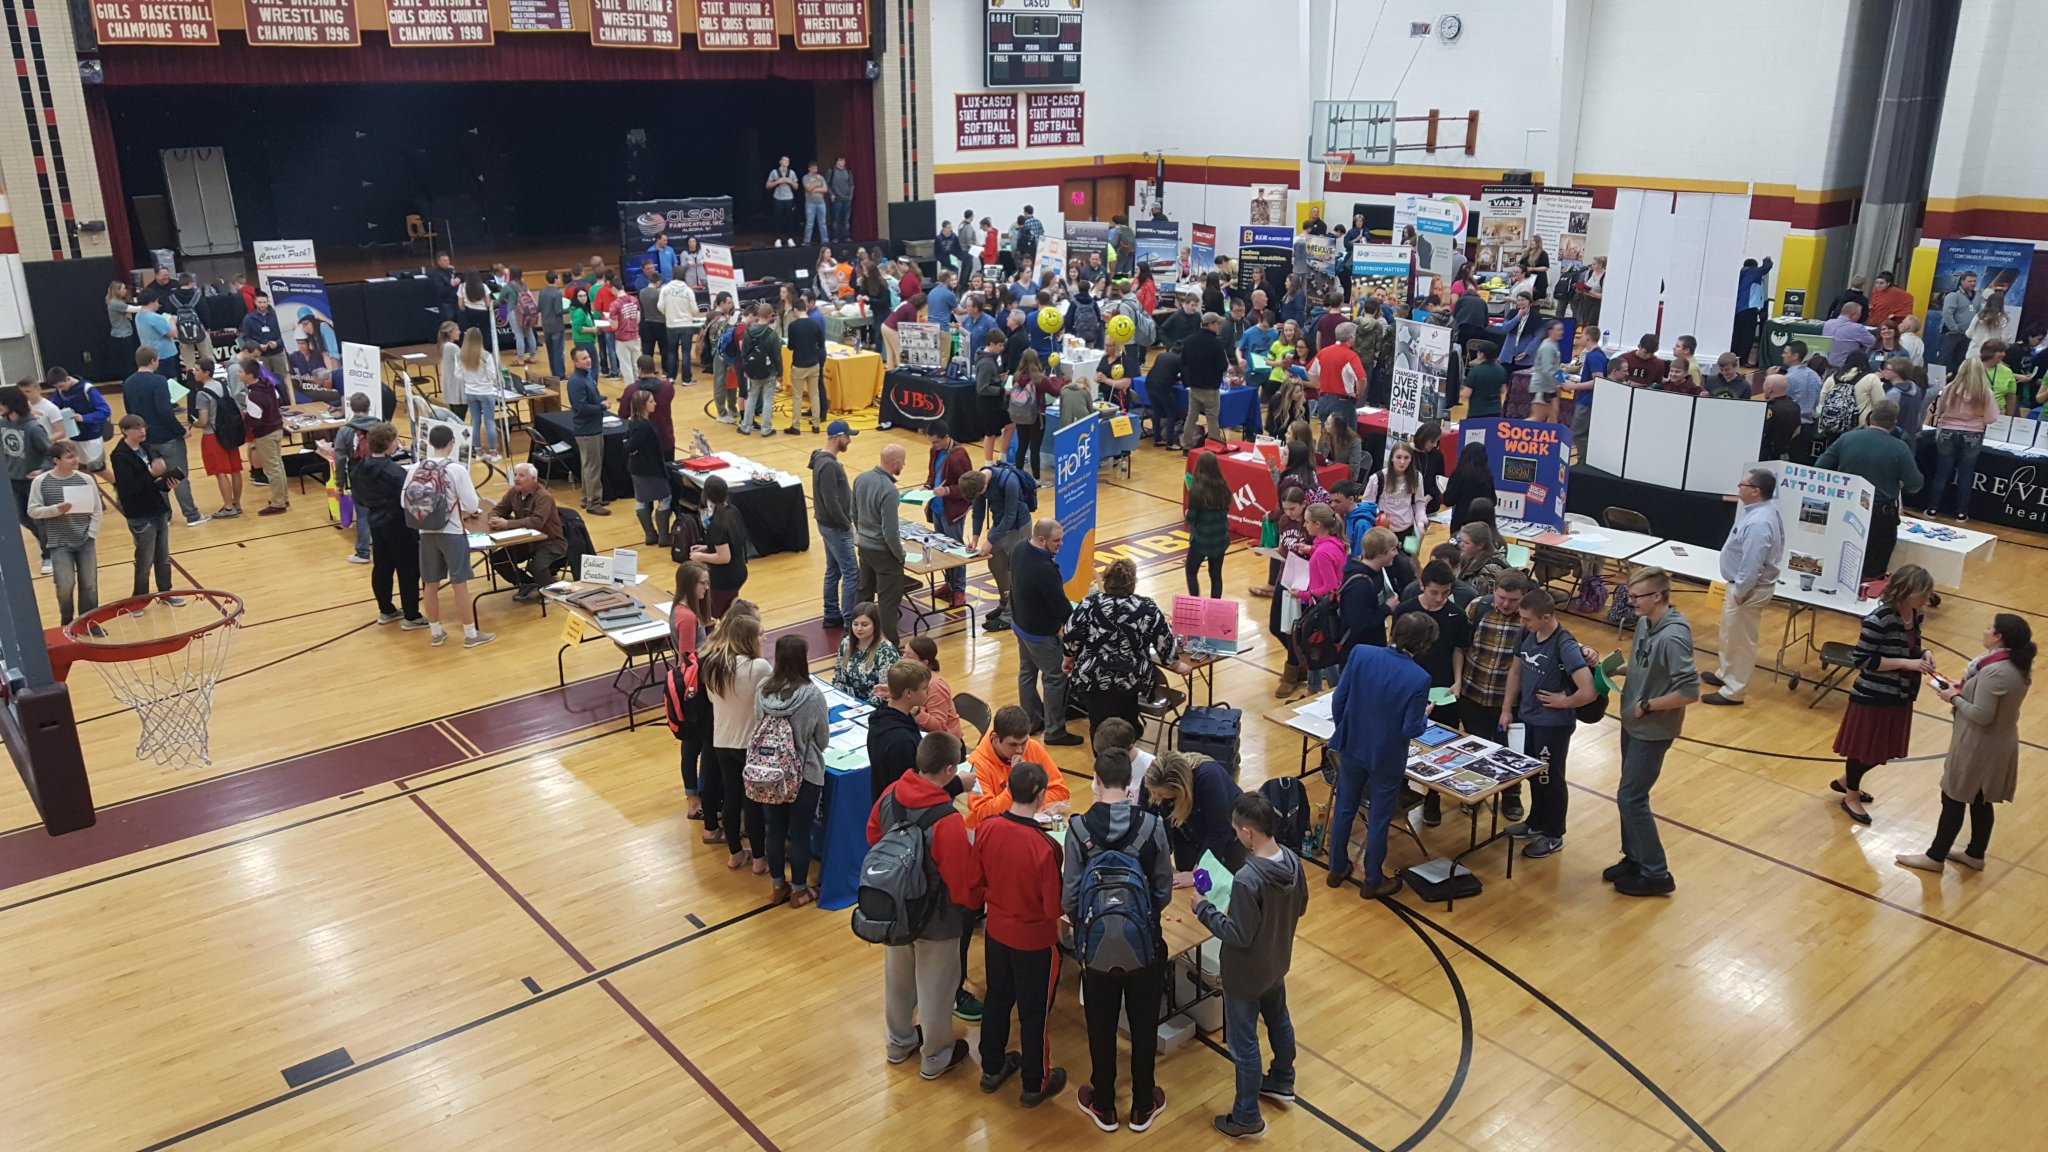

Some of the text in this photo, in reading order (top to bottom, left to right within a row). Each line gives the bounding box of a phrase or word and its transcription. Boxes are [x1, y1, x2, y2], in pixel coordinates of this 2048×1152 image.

[701, 2, 770, 16] STATE DIVISION 2
[797, 2, 862, 15] STATE DIVISION 2
[1023, 0, 1050, 8] CASCO
[96, 3, 213, 21] GIRLS BASKETBALL
[259, 7, 345, 24] WRESTLING
[388, 9, 488, 24] GIRLS CROSS COUNTRY
[991, 14, 1012, 22] HOME
[1060, 15, 1081, 23] VISITOR
[602, 12, 668, 28] WRESTLING
[699, 17, 774, 31] GIRLS CROSS COUNTRY
[804, 17, 858, 30] WRESTLING
[107, 22, 208, 39] CHAMPIONS 1994
[257, 25, 350, 41] CHAMPIONS 1996
[399, 26, 483, 41] CHAMPIONS 1998
[599, 27, 673, 43] CHAMPIONS 1999
[704, 32, 772, 45] CHAMPIONS 2000
[801, 31, 863, 45] CHAMPIONS 2001
[998, 43, 1014, 51] BONUS
[1059, 43, 1074, 51] BONUS
[962, 96, 1012, 108] LUX-CASCO
[1031, 94, 1080, 107] LUX-CASCO
[959, 108, 1016, 121] STATE DIVISION 2
[1029, 107, 1082, 119] STATE DIVISION 2
[964, 122, 1010, 133] SOFTBALL
[1033, 120, 1077, 132] SOFTBALL
[960, 133, 1016, 146] CHAMPIONS 2009
[1029, 133, 1062, 144] CHAMPIONS
[666, 207, 725, 223] OLSON
[259, 247, 311, 263] Career Path?
[1311, 244, 1333, 254] REVOLVE
[271, 284, 289, 292] BEMIS
[1394, 368, 1418, 380] CHANGING
[1393, 374, 1418, 389] LIVES
[899, 389, 935, 411] JBS
[1392, 385, 1417, 402] ONE
[1391, 397, 1416, 412] CHAIR
[1402, 409, 1414, 418] TIME
[1497, 421, 1559, 443] SOCIAL
[1504, 439, 1550, 456] WORK
[1057, 437, 1092, 486] HOPE
[1784, 465, 1851, 486] DISTRICT
[1780, 478, 1854, 500] ATTORNEY
[1233, 483, 1257, 511] KI
[582, 557, 605, 569] Cabinet
[584, 569, 610, 580] Creations
